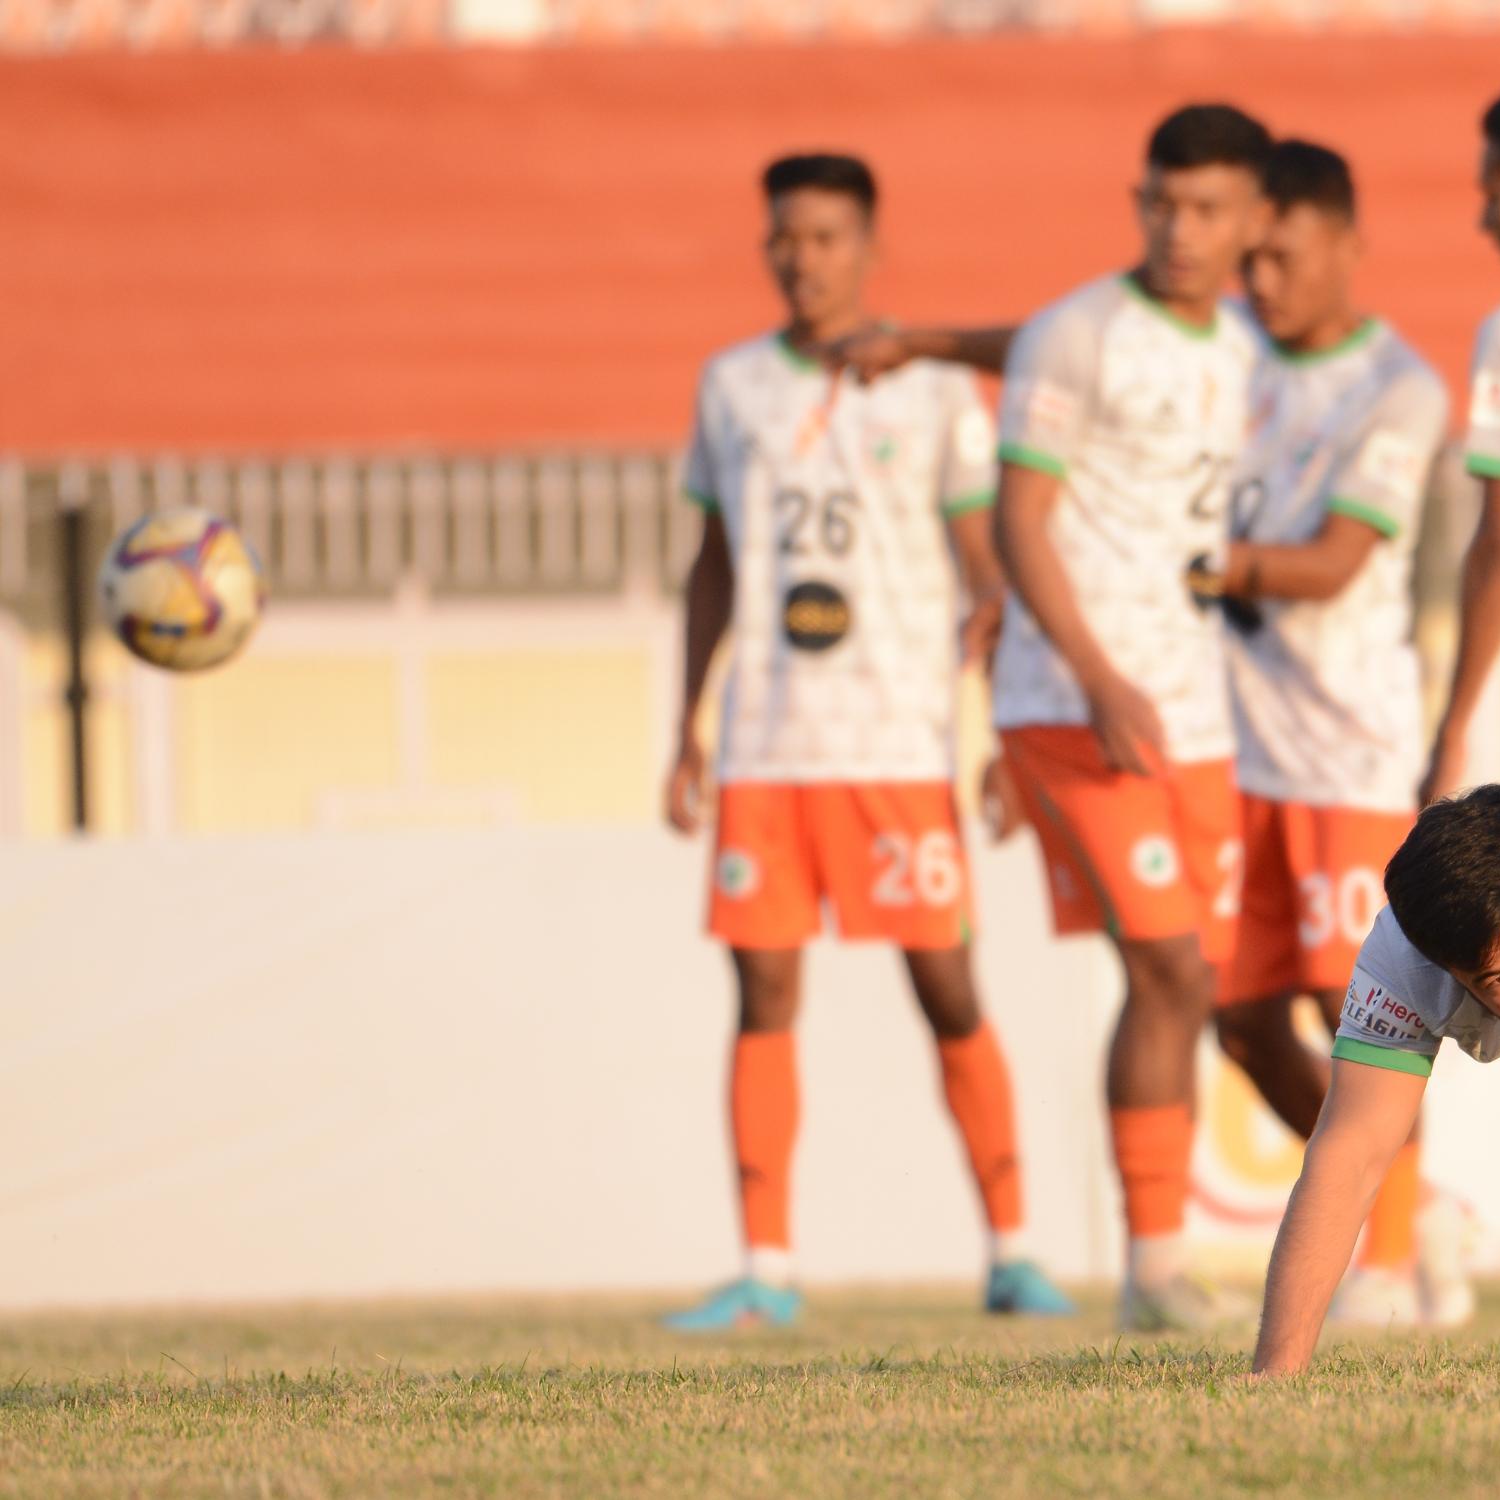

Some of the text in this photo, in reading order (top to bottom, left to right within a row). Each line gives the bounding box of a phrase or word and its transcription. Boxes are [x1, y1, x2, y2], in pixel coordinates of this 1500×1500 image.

[776, 487, 863, 559] 26
[873, 832, 961, 907] 26
[1298, 869, 1386, 947] 30
